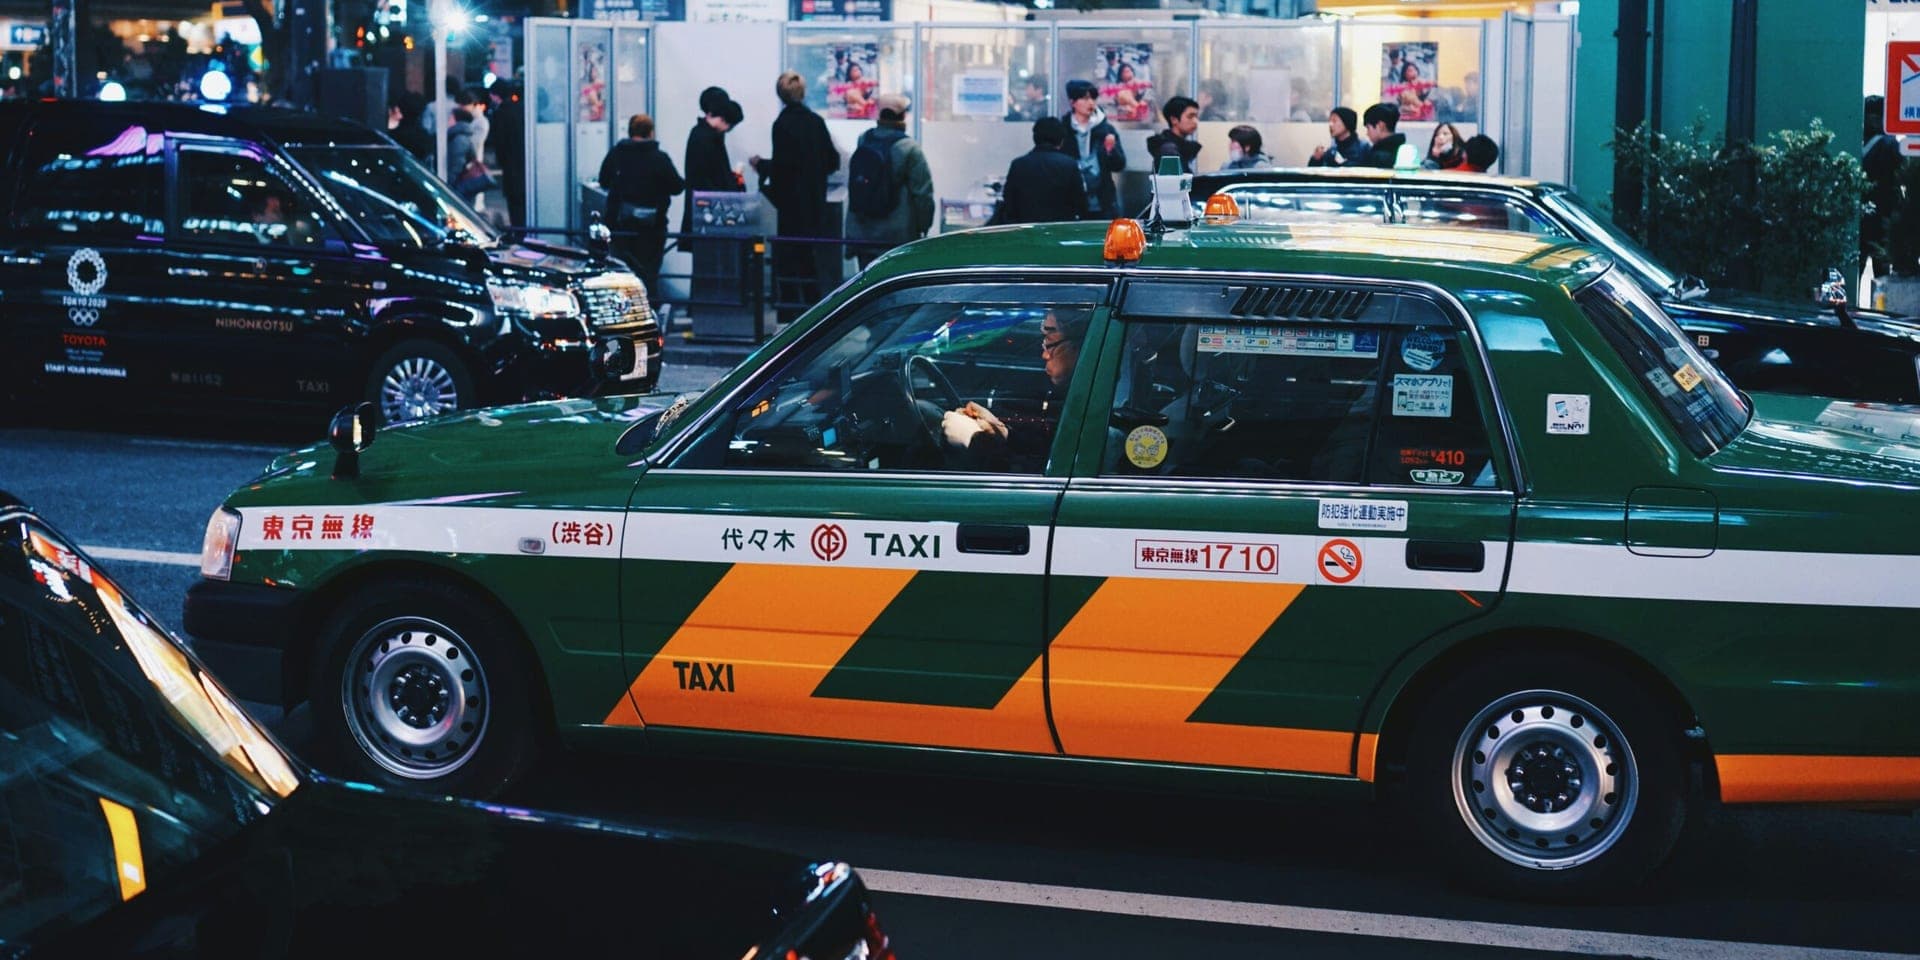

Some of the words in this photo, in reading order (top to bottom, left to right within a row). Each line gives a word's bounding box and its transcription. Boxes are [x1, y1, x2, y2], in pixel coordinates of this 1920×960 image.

[62, 296, 87, 306] TOKYO
[88, 298, 107, 308] 2020
[215, 318, 293, 331] NIHONKOTSU
[63, 334, 107, 346] TOYOTA
[45, 364, 65, 373] START
[67, 365, 85, 375] YOUR
[87, 366, 127, 377] IMPOSSIBLE
[296, 380, 329, 393] TAXI
[1321, 503, 1405, 521] 防犯強化運動実施中
[262, 513, 375, 541] 東京無線
[552, 521, 614, 547] (渋谷)
[721, 527, 796, 552] 代々木
[864, 532, 941, 559] TAXI
[1141, 546, 1199, 564] 東京無線
[1200, 544, 1276, 572] 1710
[673, 661, 735, 692] TAXI
